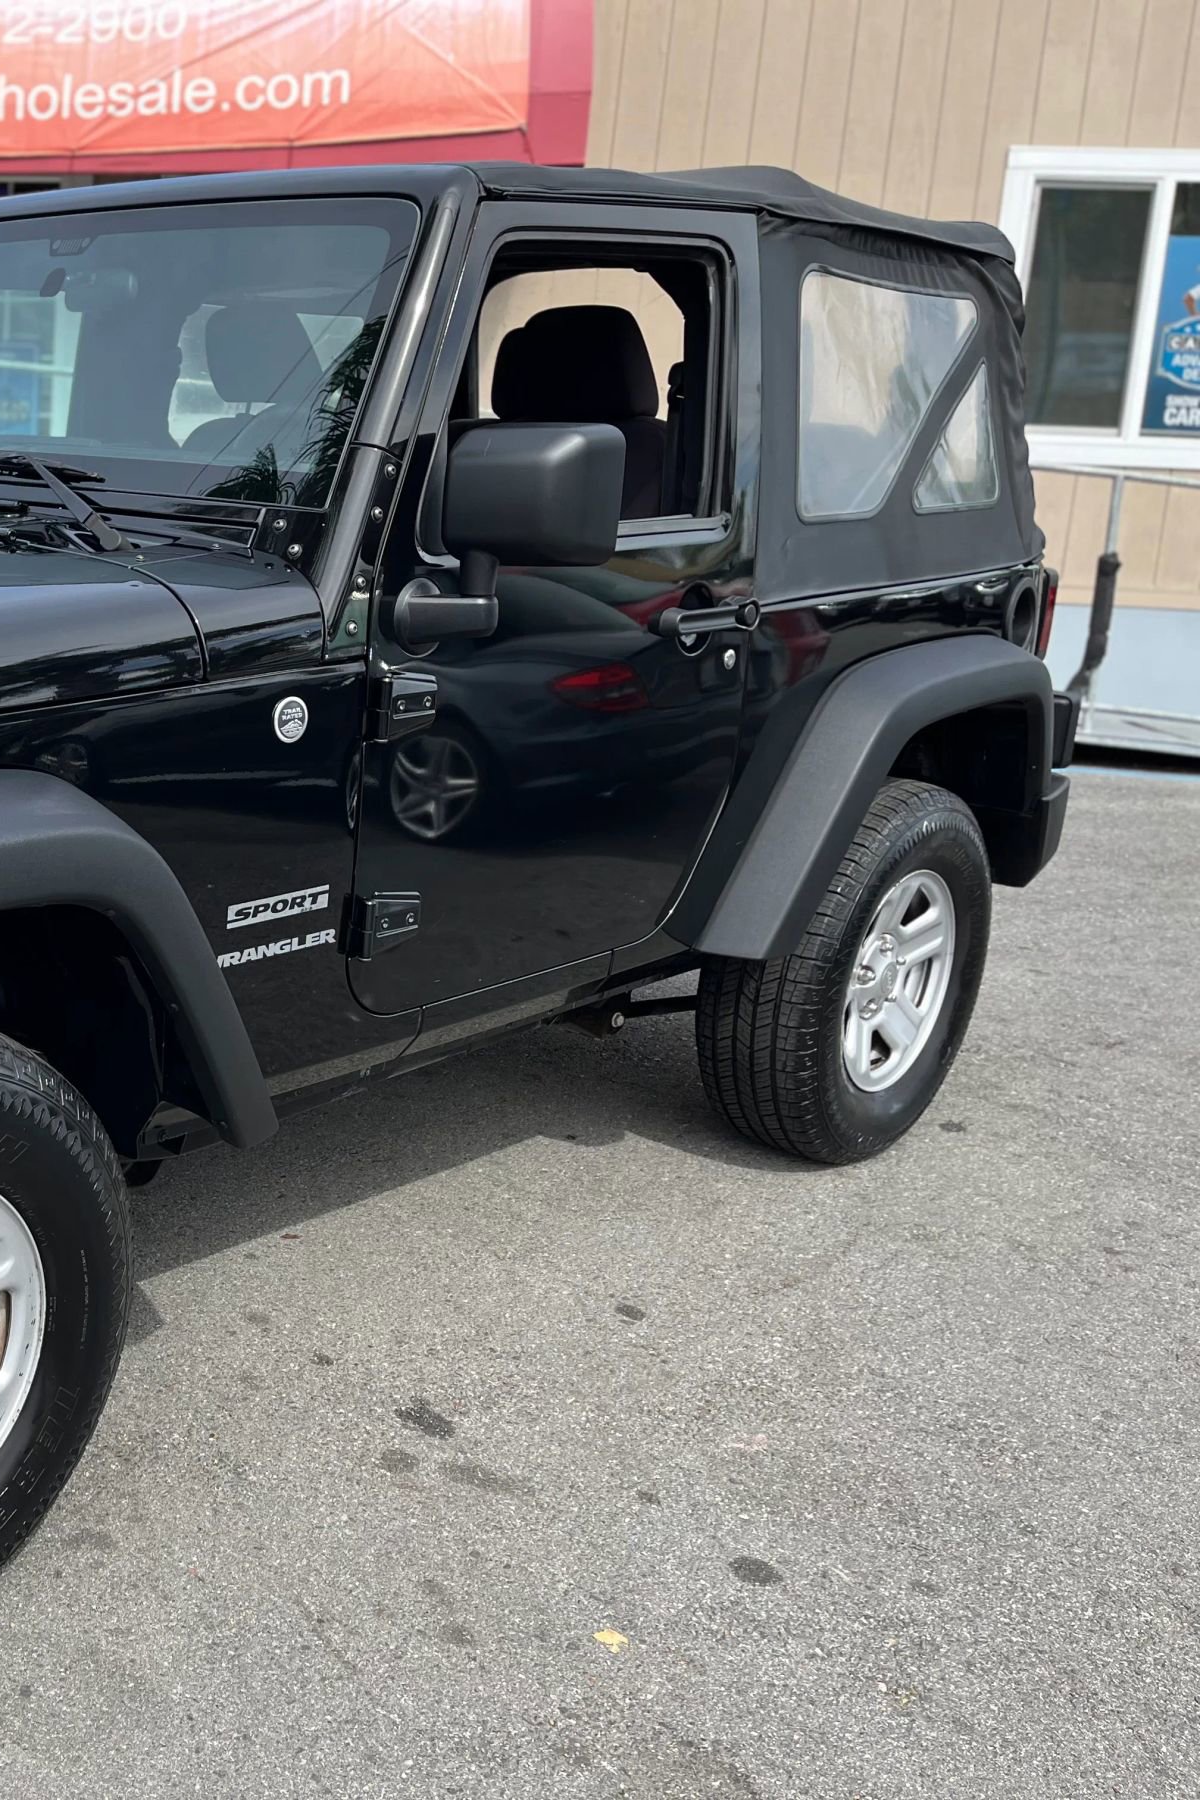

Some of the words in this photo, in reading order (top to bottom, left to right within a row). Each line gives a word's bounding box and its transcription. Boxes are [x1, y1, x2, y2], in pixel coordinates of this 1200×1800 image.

[283, 707, 302, 715] TRAIL
[281, 712, 303, 721] RATED
[230, 890, 327, 922] SPORT
